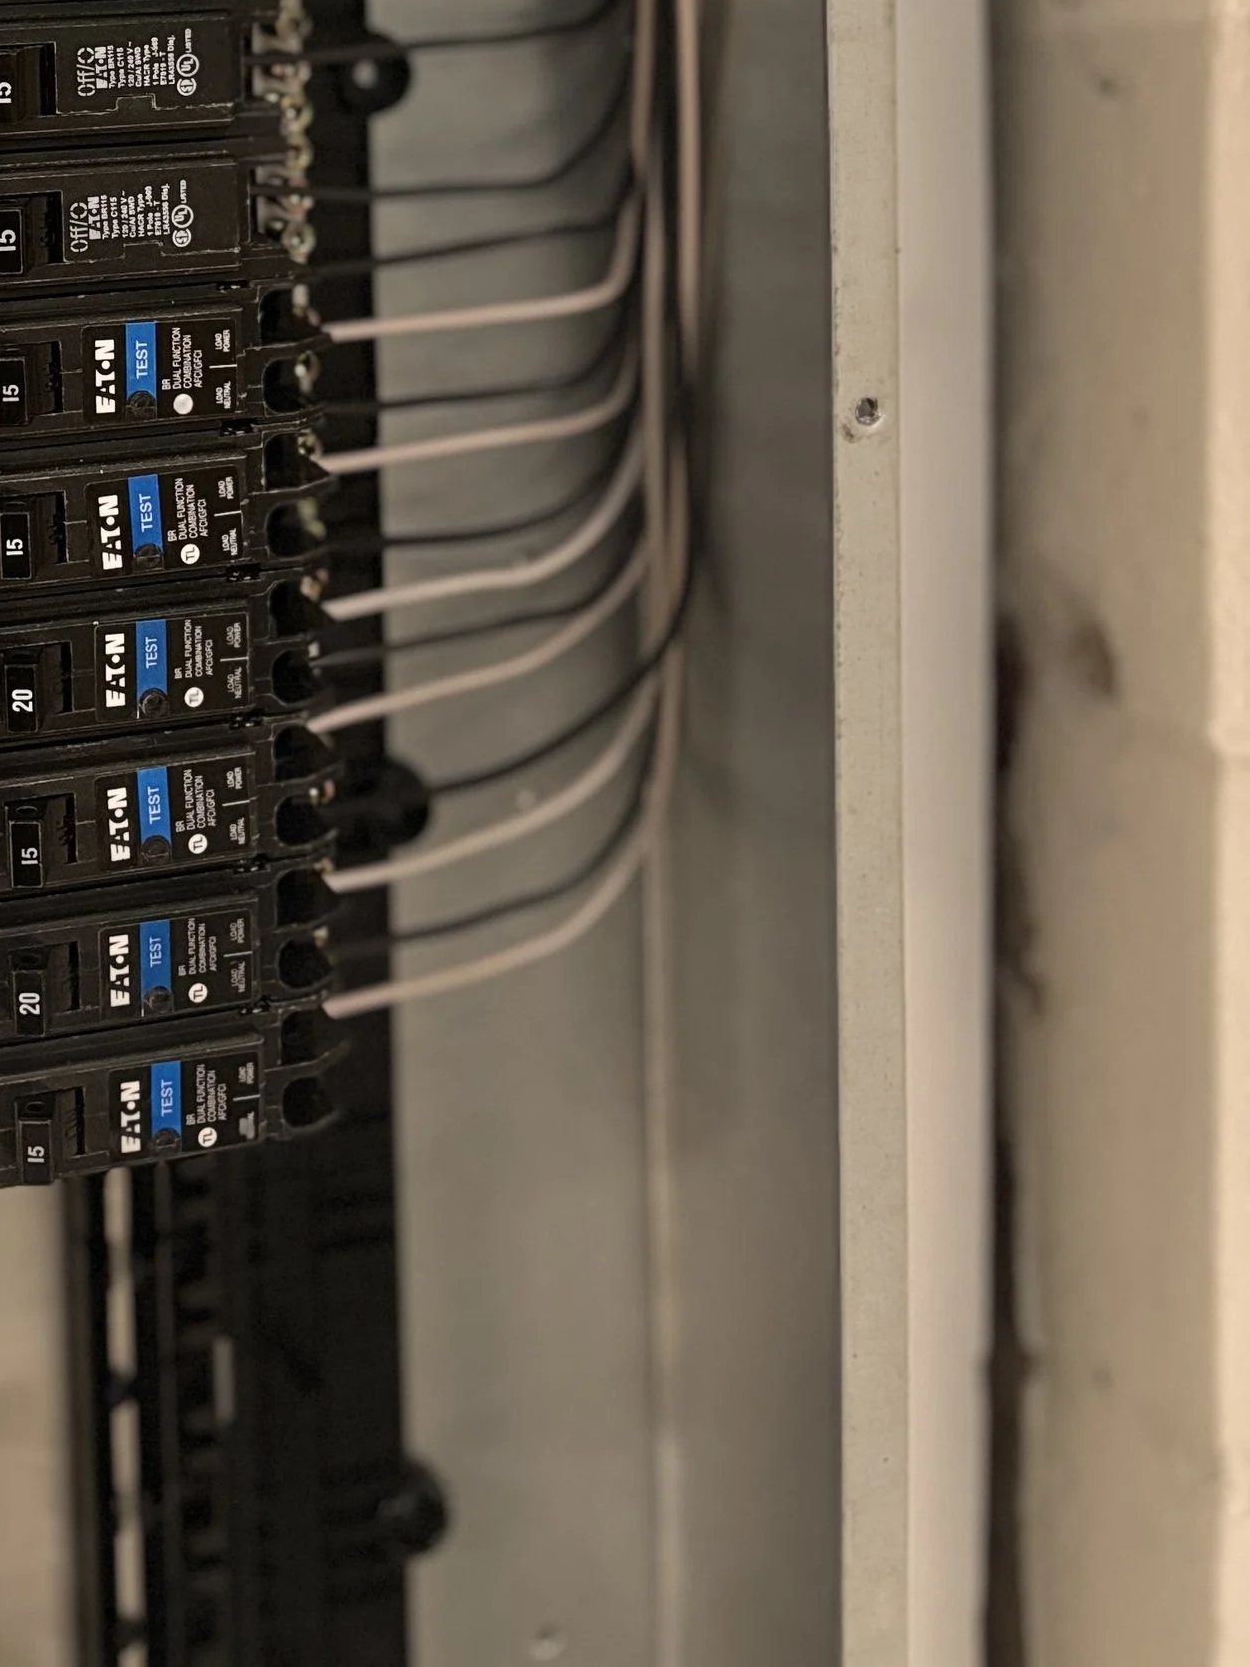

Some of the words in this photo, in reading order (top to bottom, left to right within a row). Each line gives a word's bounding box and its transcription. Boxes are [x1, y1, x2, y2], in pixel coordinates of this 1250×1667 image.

[95, 46, 107, 89] EATON
[88, 196, 101, 240] EATON
[136, 340, 148, 379] TEST
[172, 327, 181, 366] FUNCTION
[214, 332, 222, 351] LOAD
[95, 339, 115, 414] EATON
[172, 367, 182, 389] DUAL
[182, 334, 192, 390] COMBINATION
[193, 350, 203, 388] AFCI/GFCI
[2, 384, 19, 402] 15
[162, 378, 171, 390] BR
[215, 387, 223, 406] LOAD
[223, 381, 231, 409] NEUTRAL
[98, 494, 122, 570] EATON
[140, 493, 153, 533] TEST
[6, 538, 23, 556] 15
[105, 634, 125, 707] EATON
[145, 637, 157, 669] TEST
[13, 689, 32, 712] 20
[148, 786, 160, 824] TEST
[107, 788, 130, 862] EATON
[21, 847, 38, 865] 15
[109, 934, 129, 1007] EATON
[150, 936, 161, 968] TEST
[19, 992, 40, 1015] 20
[120, 1081, 141, 1153] EATON
[161, 1079, 173, 1117] TEST
[28, 1146, 44, 1163] 15
